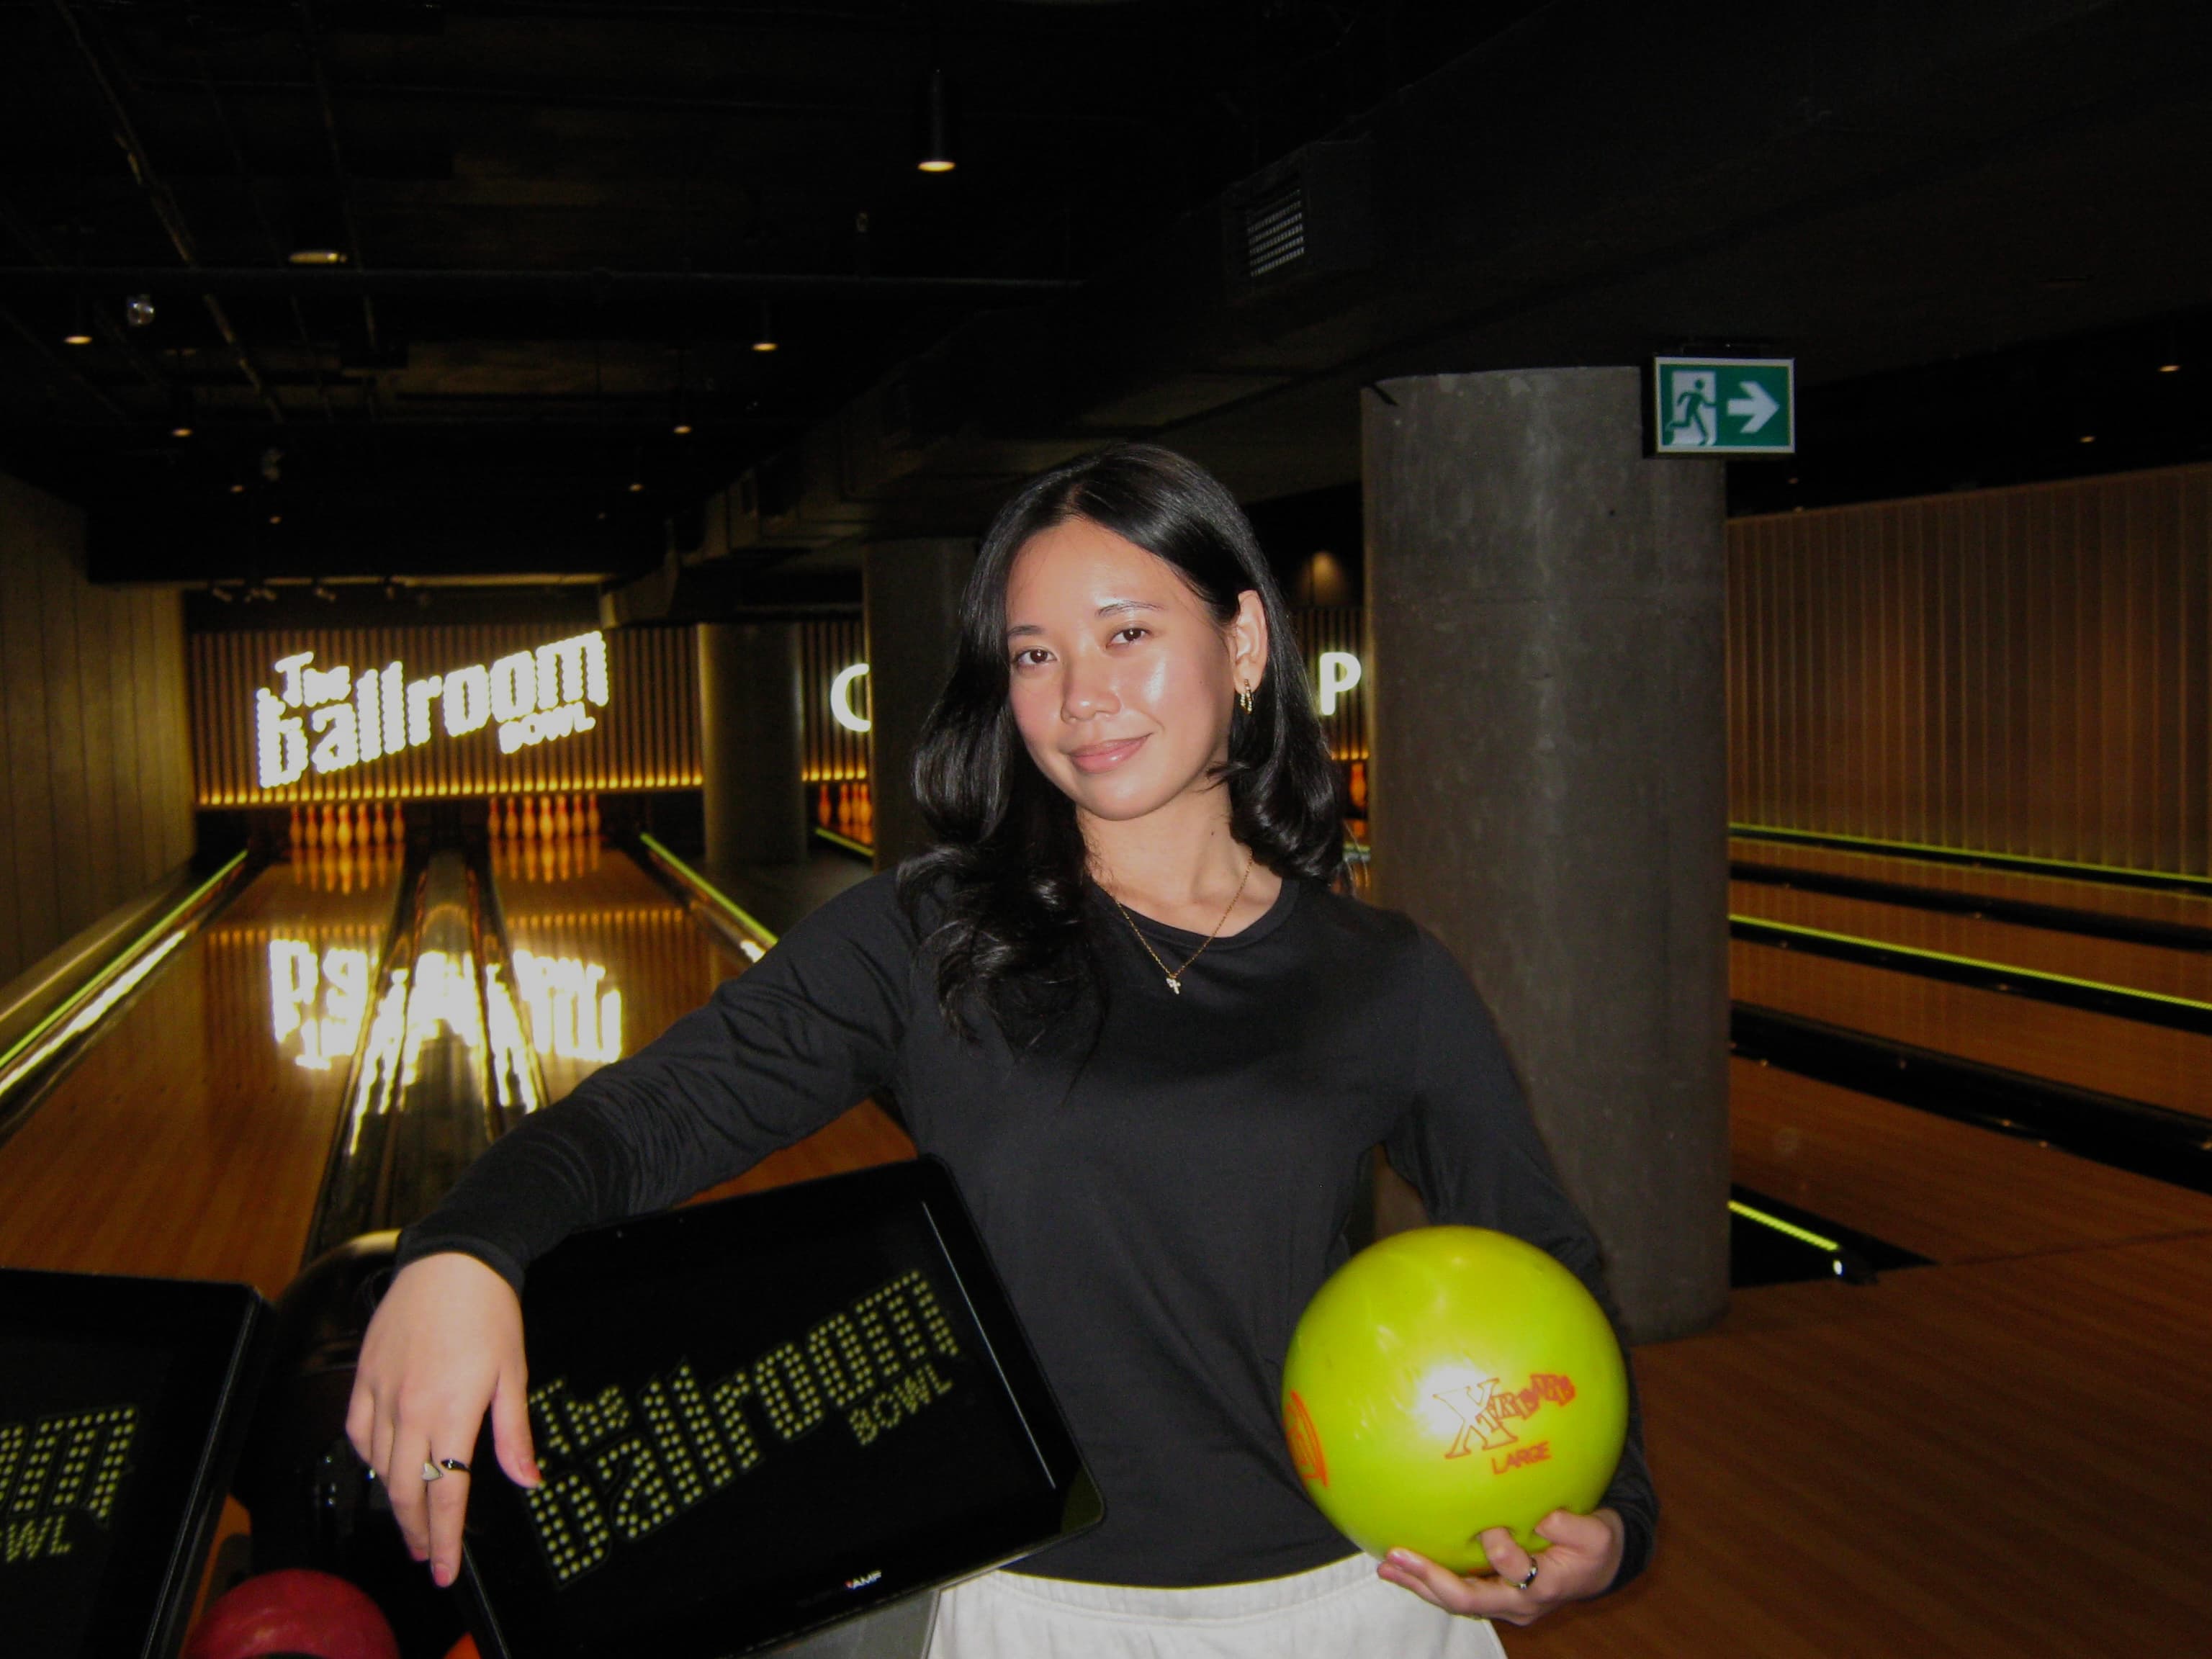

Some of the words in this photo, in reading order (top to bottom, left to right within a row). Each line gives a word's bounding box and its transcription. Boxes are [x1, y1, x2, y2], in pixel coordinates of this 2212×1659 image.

[256, 629, 609, 789] ballroom
[274, 651, 351, 708] The
[850, 1364, 953, 1445] BOWL
[1491, 1440, 1552, 1475] LARGE
